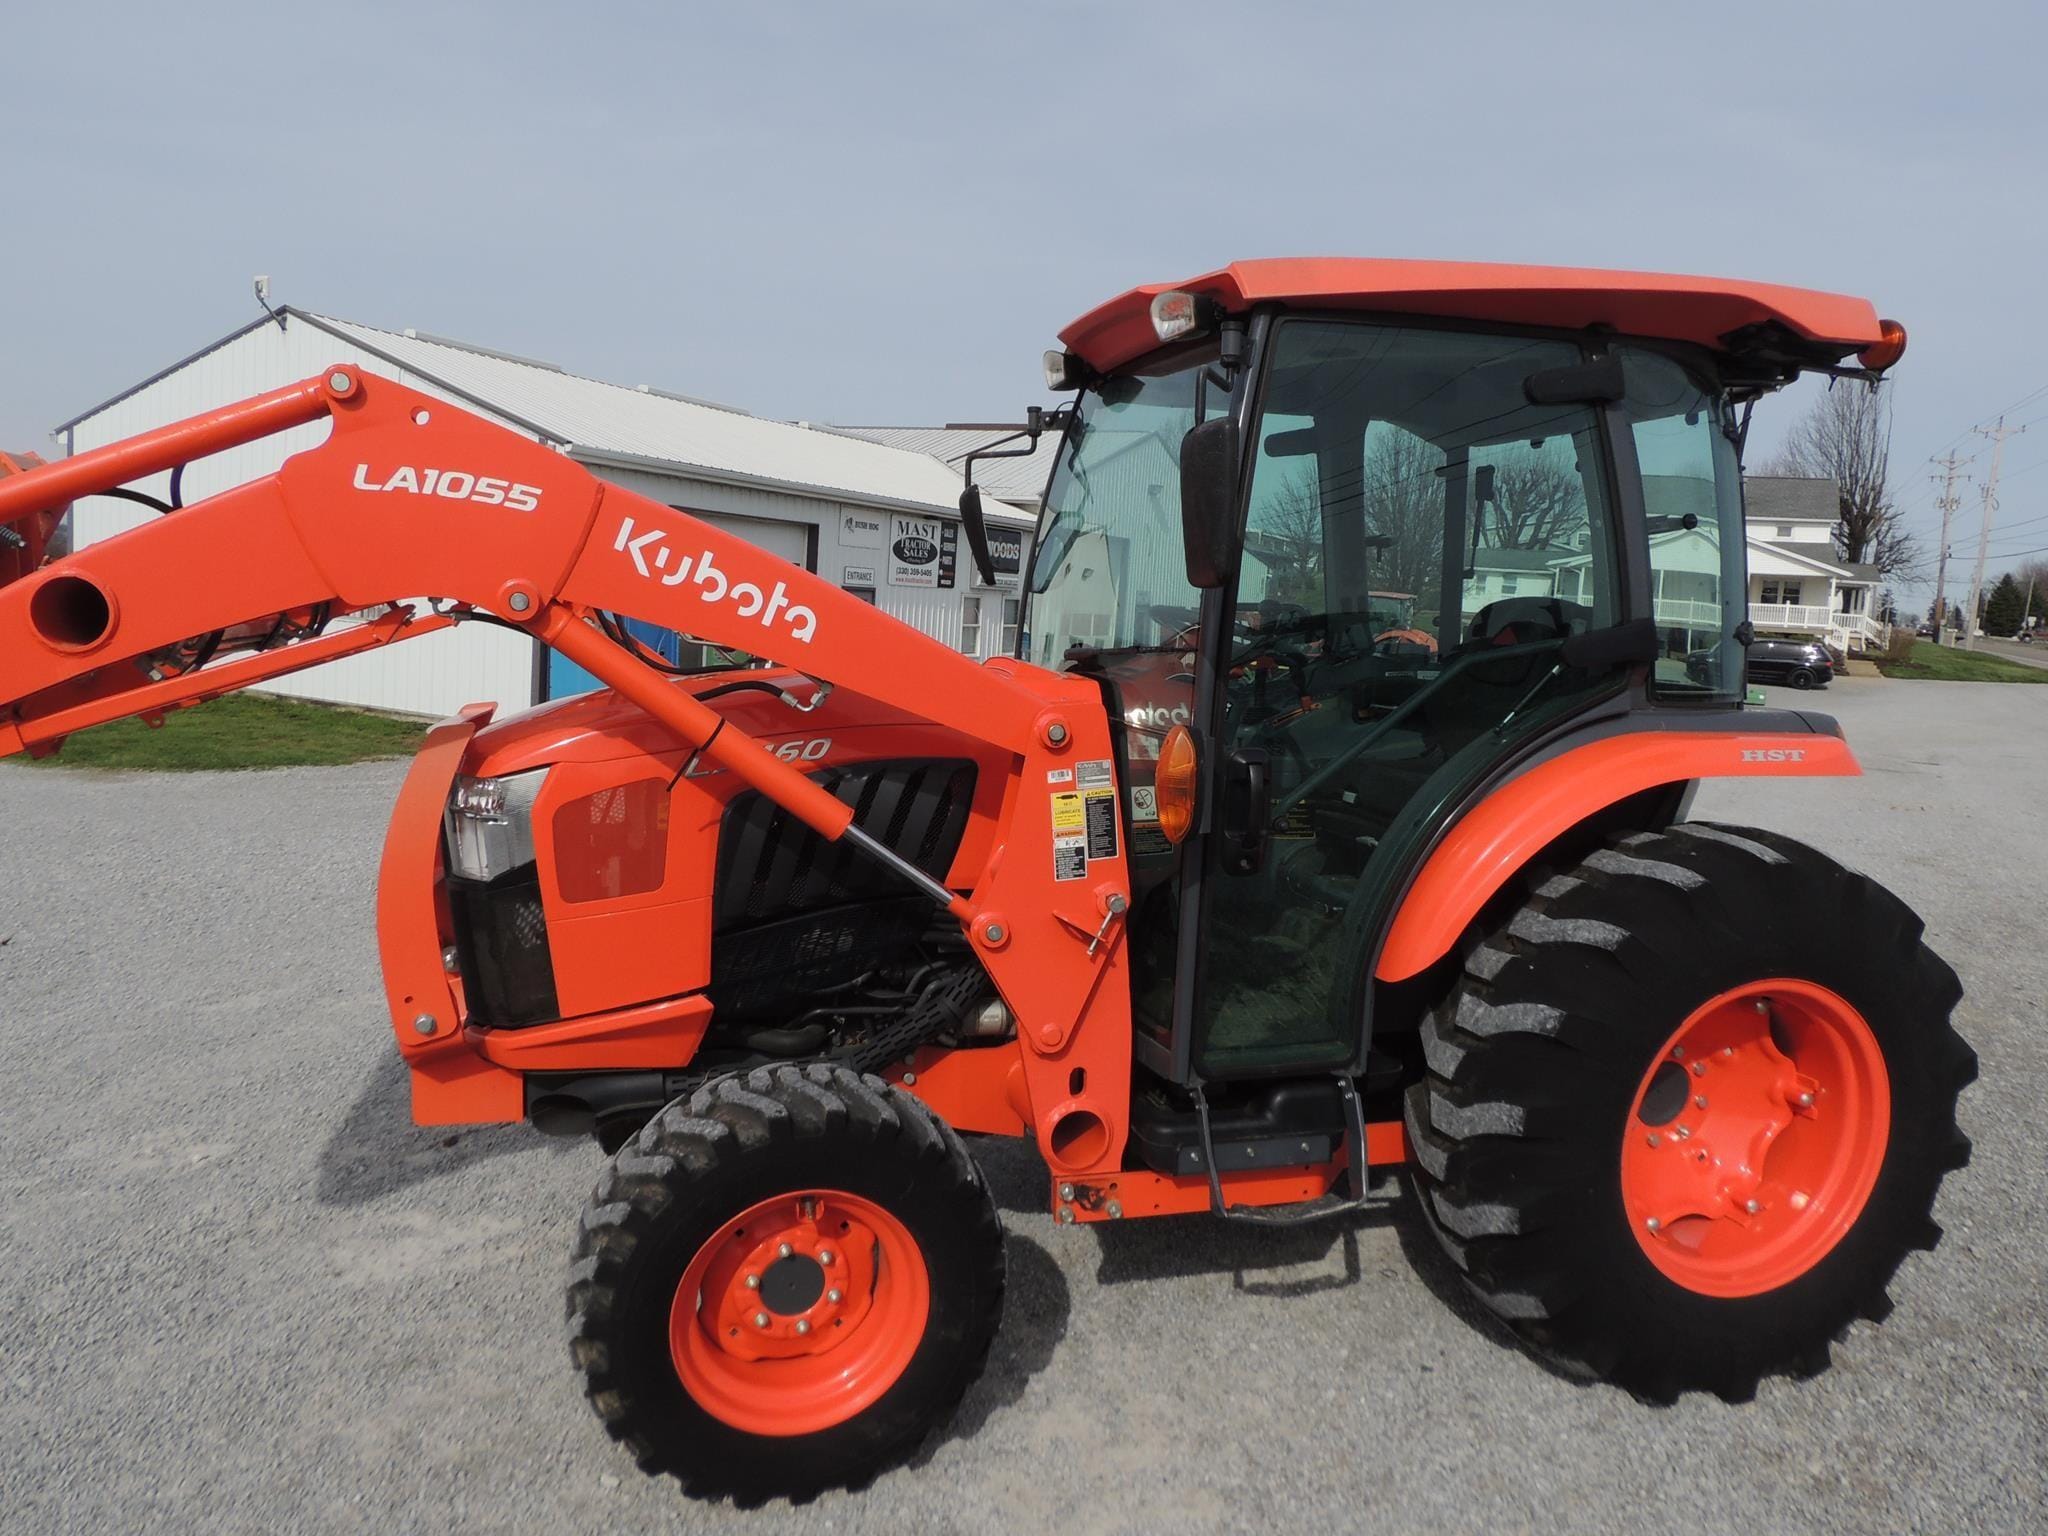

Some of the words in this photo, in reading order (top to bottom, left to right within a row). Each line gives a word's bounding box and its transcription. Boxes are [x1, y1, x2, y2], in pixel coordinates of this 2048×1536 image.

[353, 463, 543, 512] LA1055
[855, 521, 868, 529] BUSH
[868, 522, 880, 531] HOG
[897, 520, 938, 539] MAST
[901, 536, 931, 551] TRACTOR
[903, 547, 929, 558] SALES
[613, 516, 818, 644] Kubota
[847, 570, 872, 581] ENTRANCE
[1741, 749, 1806, 762] HST
